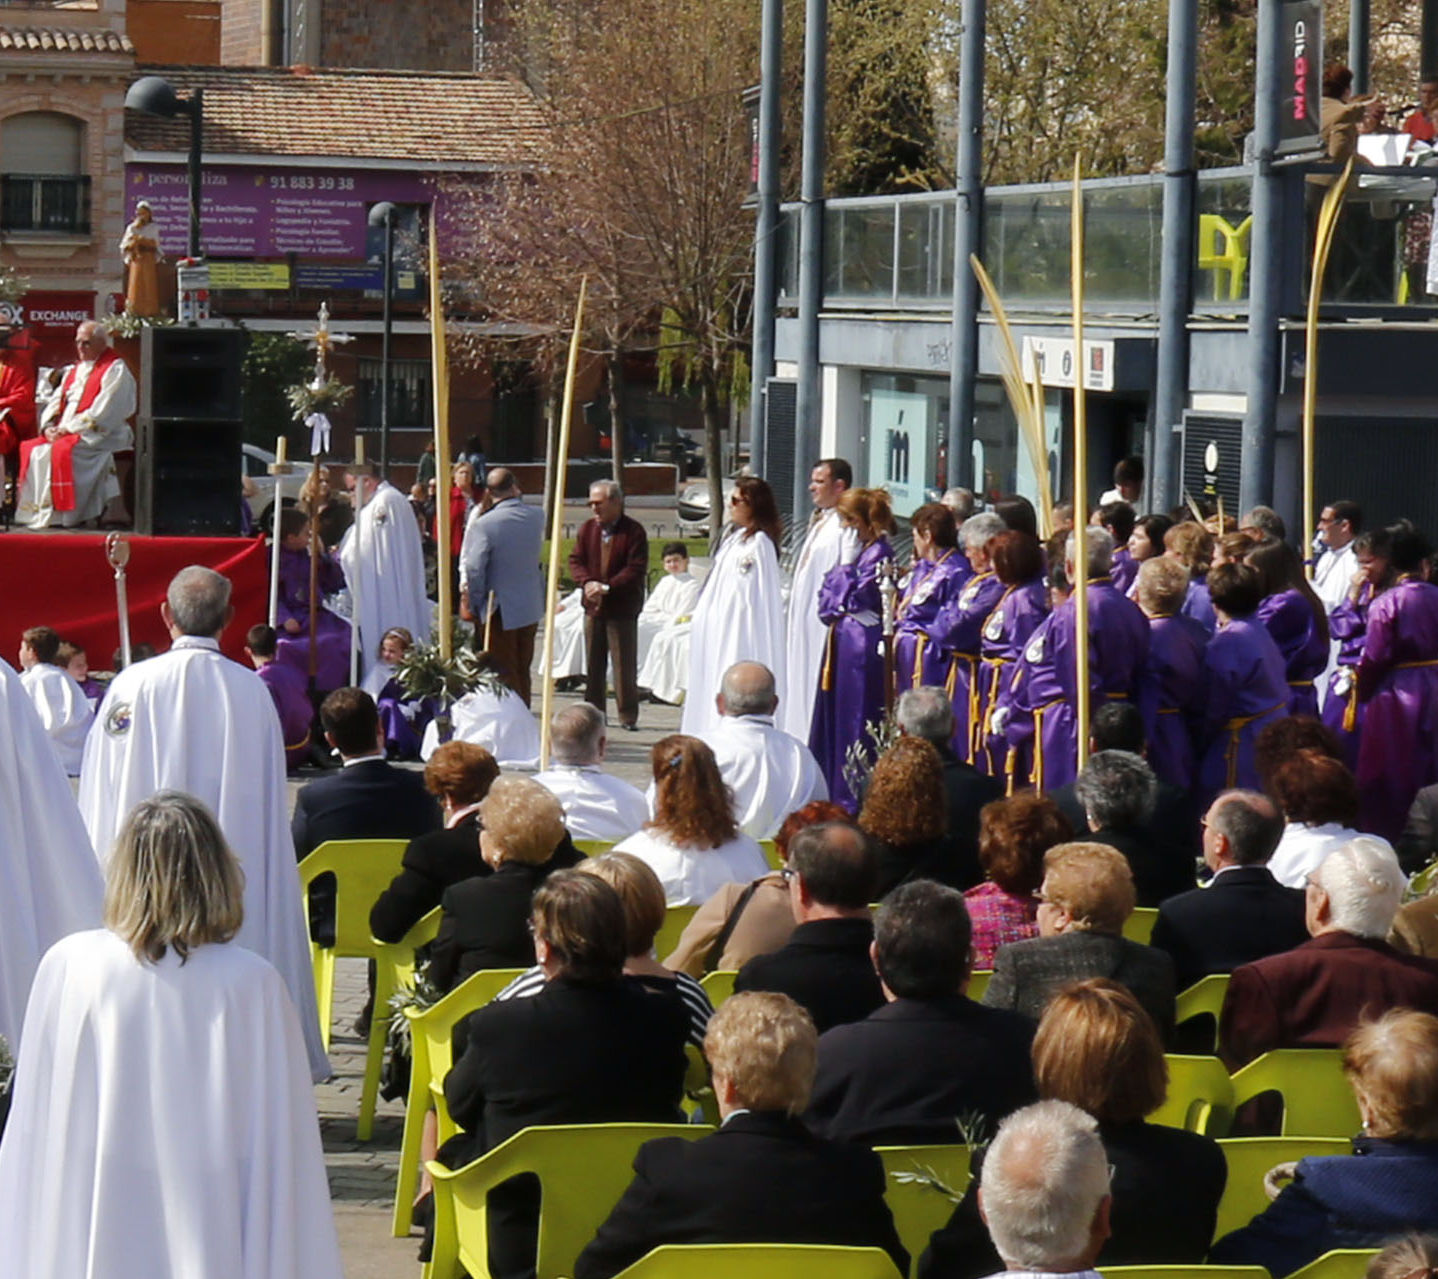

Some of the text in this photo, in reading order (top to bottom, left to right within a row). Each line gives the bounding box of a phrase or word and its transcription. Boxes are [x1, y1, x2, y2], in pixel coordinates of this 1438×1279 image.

[1293, 20, 1307, 120] MADRID
[148, 171, 228, 187] persoliza
[270, 175, 355, 191] 91 883 39 38
[30, 310, 89, 322] EXCHANGE
